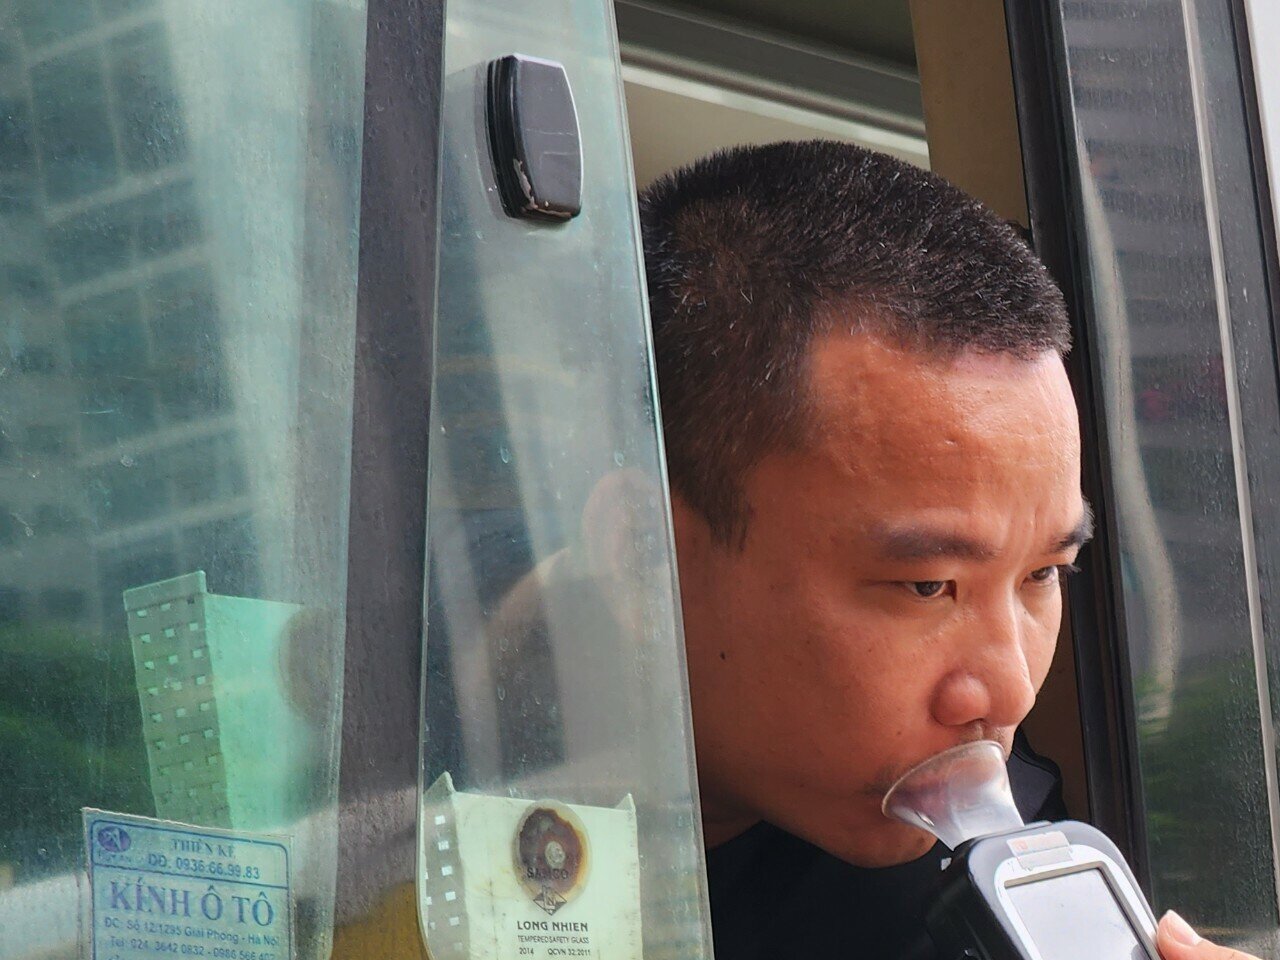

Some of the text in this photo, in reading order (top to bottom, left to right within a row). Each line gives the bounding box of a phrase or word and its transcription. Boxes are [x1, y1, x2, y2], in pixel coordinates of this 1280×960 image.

[109, 877, 274, 927] KÍNH Ô TÔ
[517, 921, 589, 932] LONG NHIEN
[571, 936, 590, 944] GLASS
[548, 948, 567, 956] QCVN
